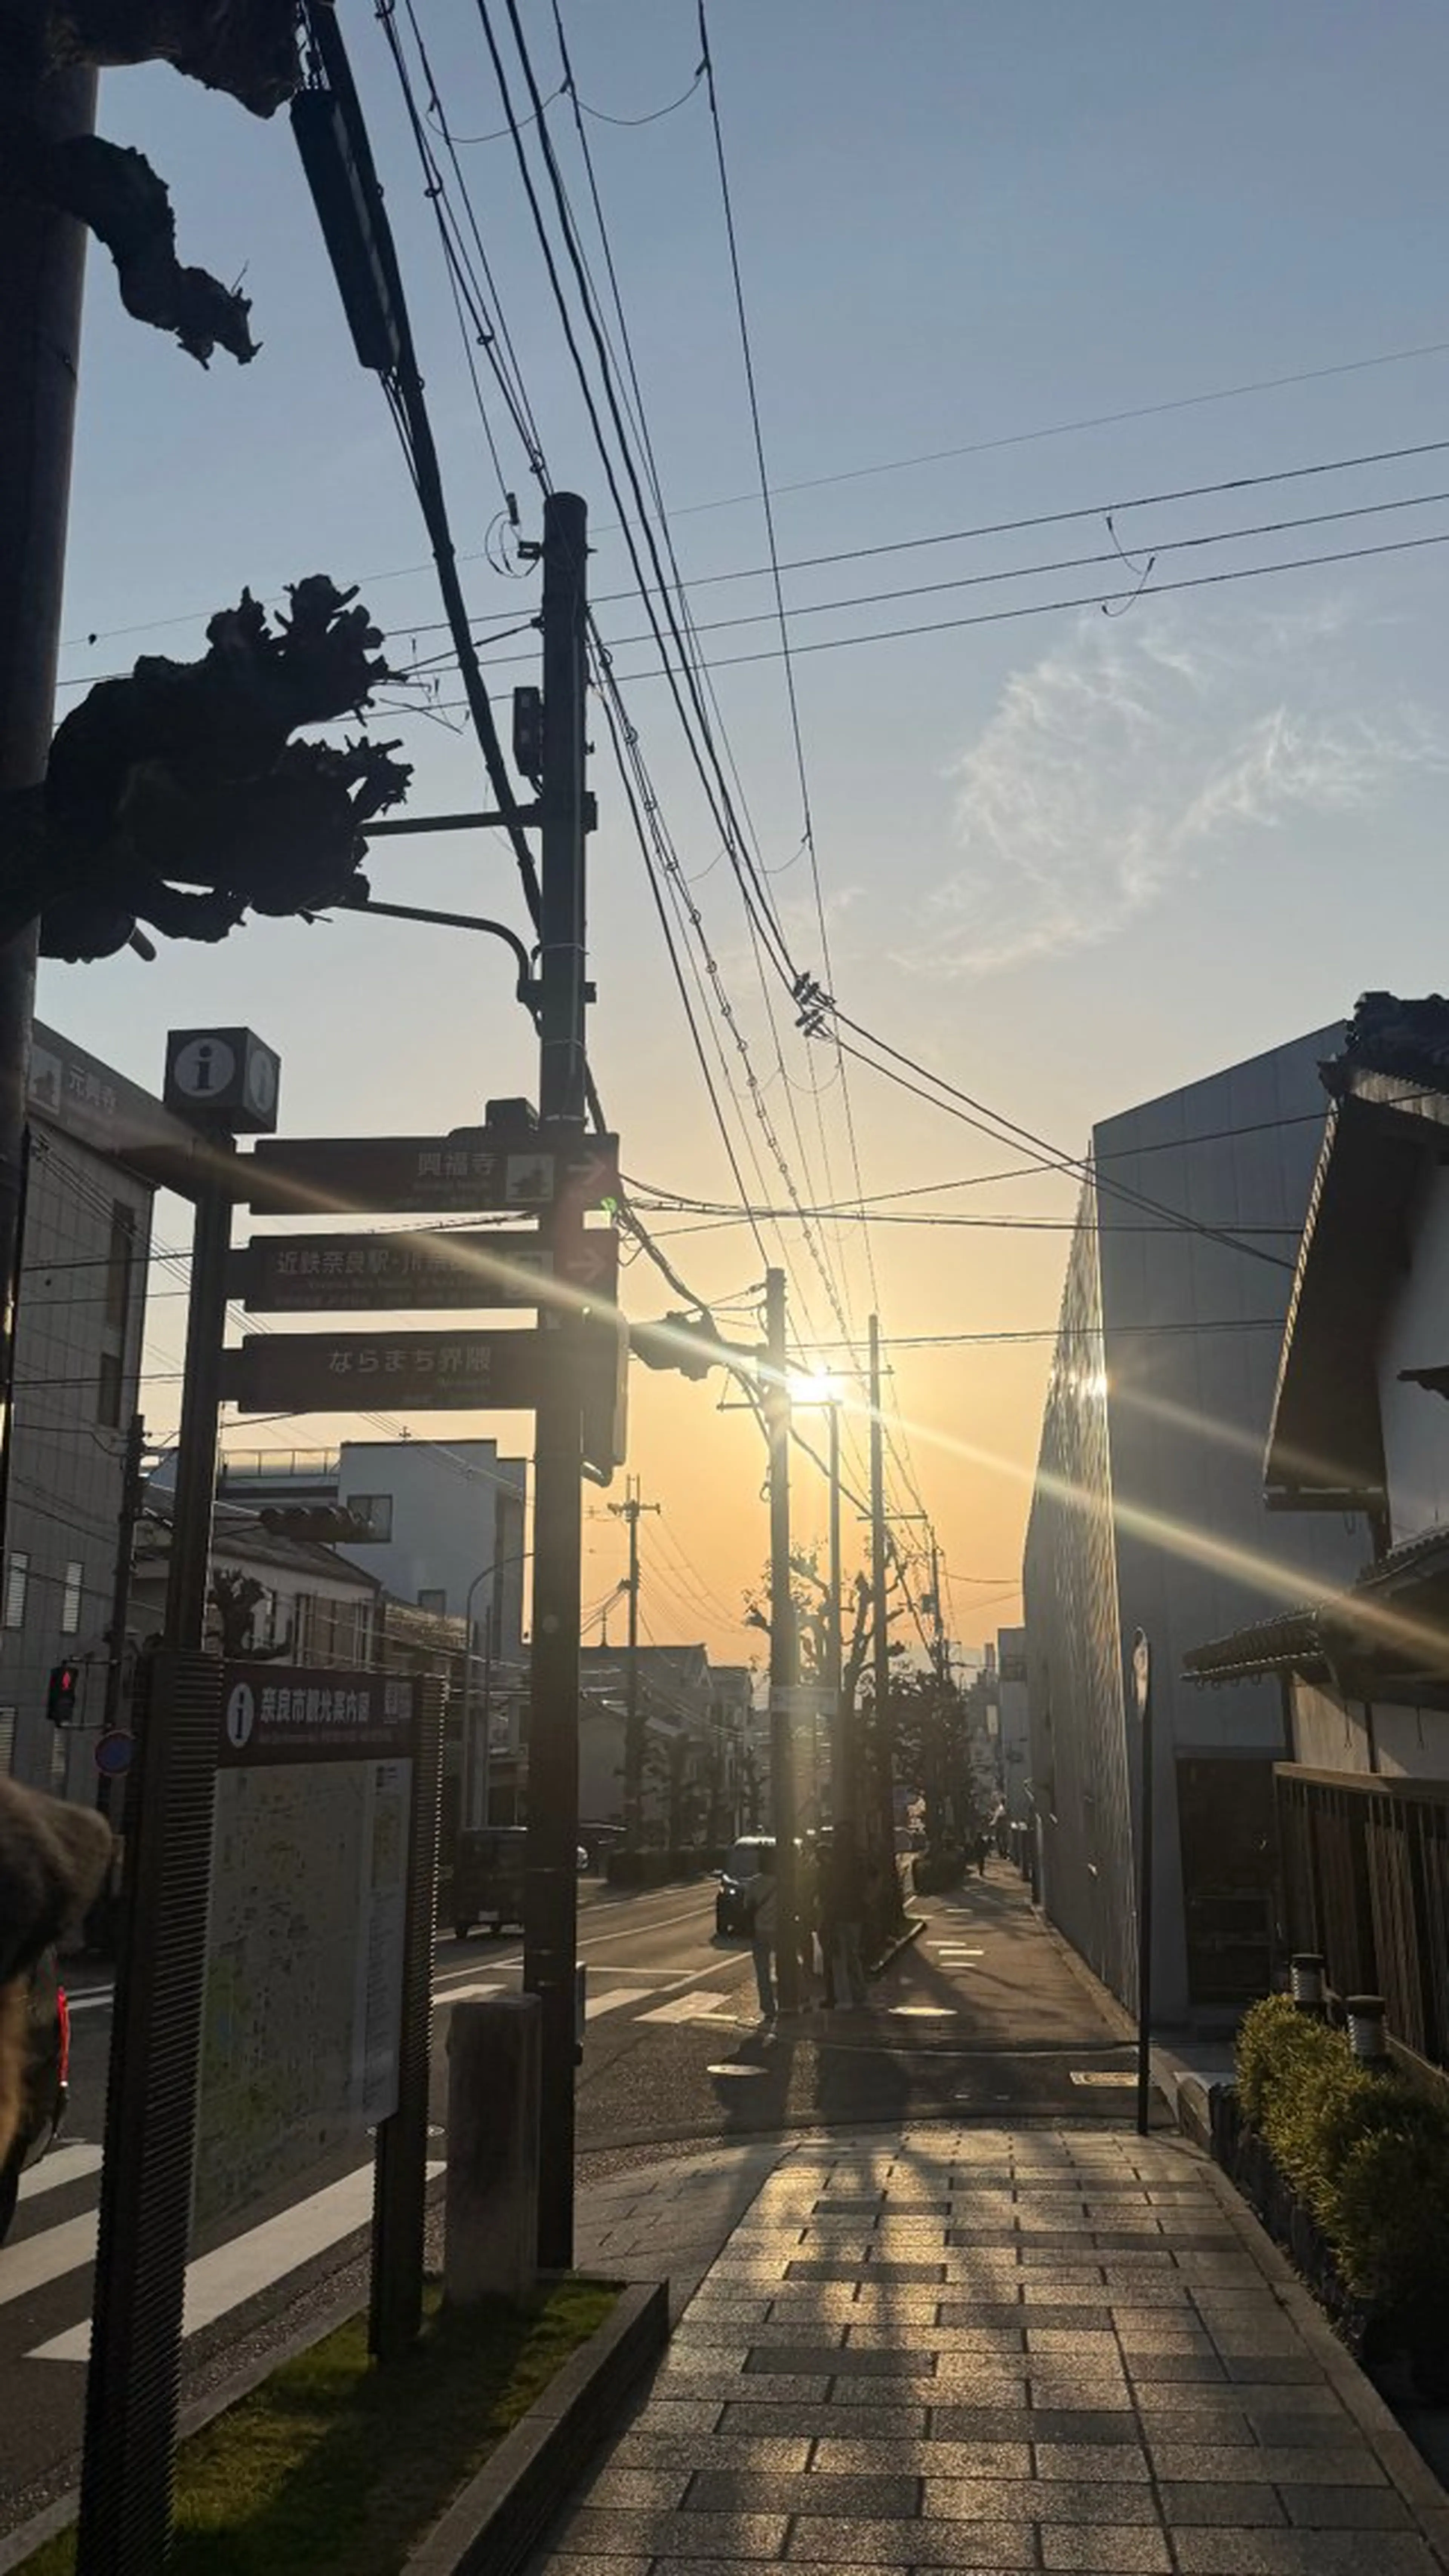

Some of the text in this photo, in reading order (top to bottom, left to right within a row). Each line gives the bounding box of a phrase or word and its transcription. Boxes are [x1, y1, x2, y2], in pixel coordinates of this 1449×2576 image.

[417, 1152, 499, 1179] 興福寺
[326, 1346, 492, 1374] ならまち界隈
